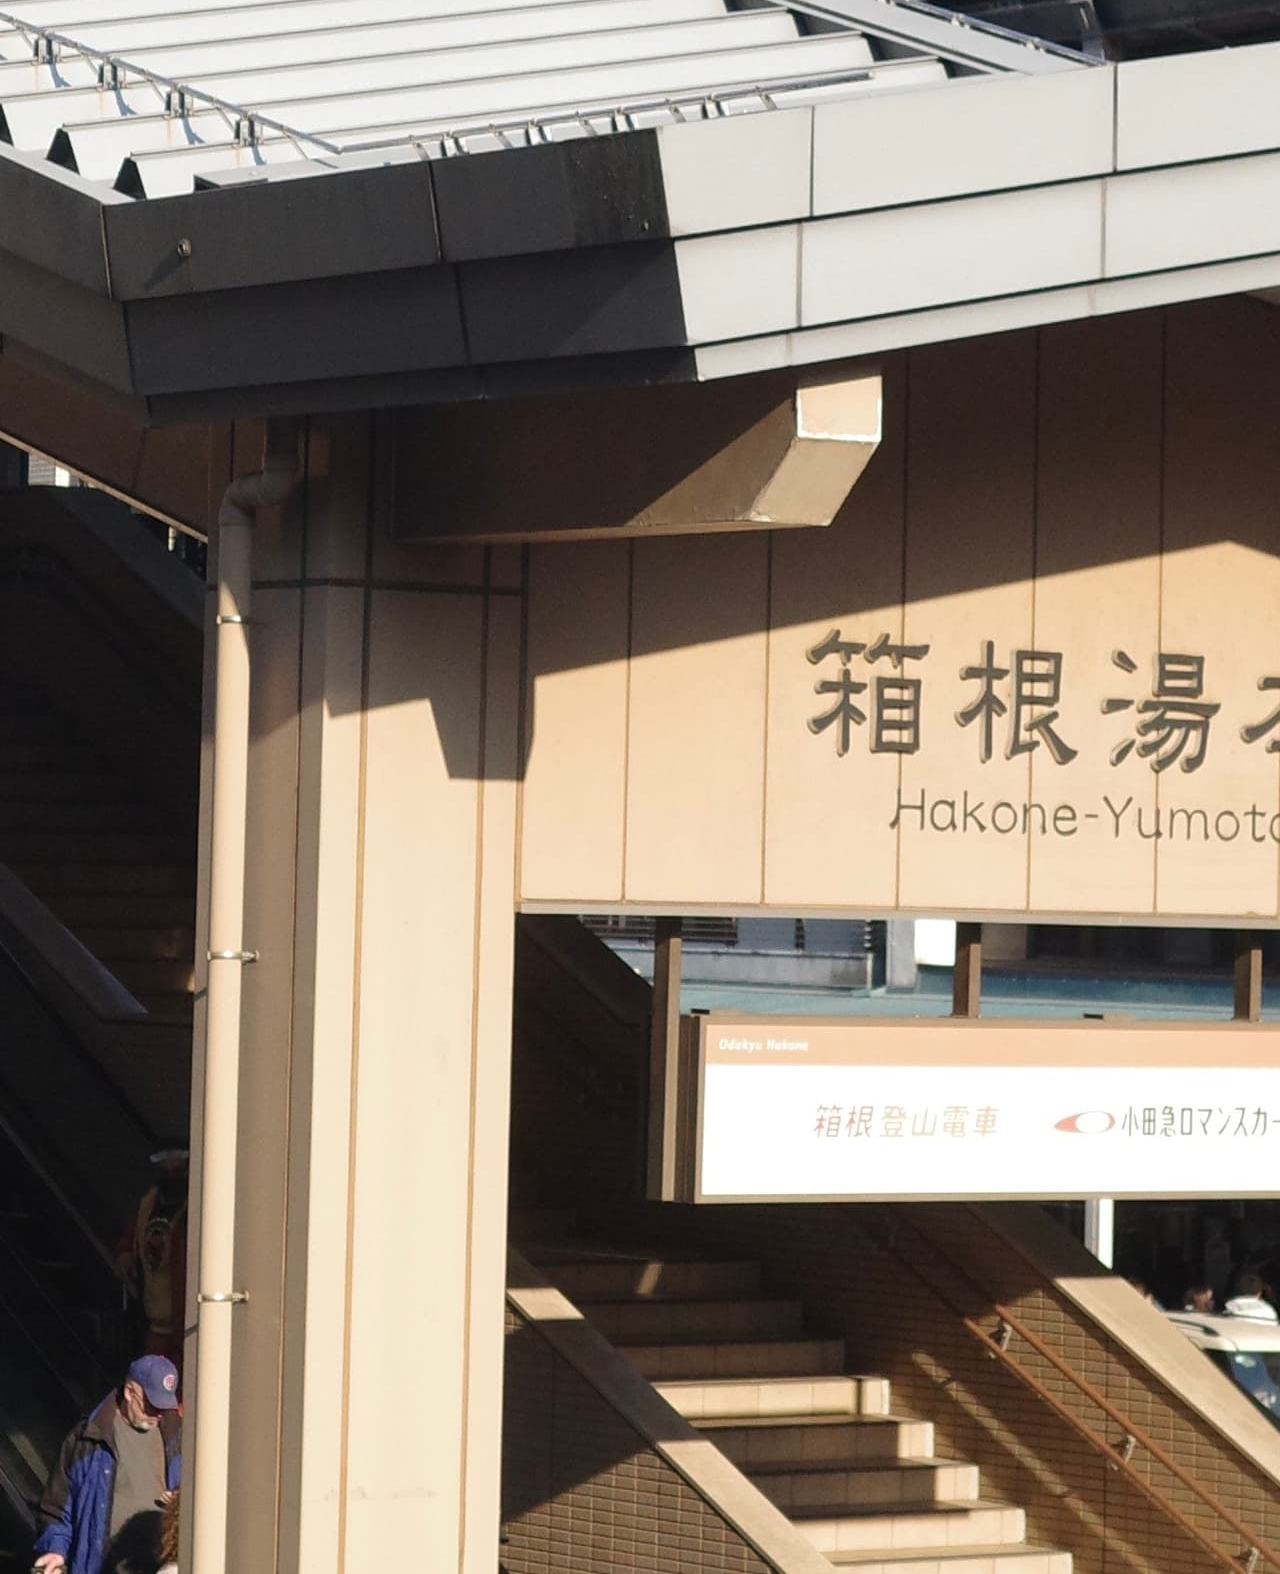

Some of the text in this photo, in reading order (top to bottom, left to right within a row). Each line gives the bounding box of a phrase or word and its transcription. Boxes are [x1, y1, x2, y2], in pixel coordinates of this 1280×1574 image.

[719, 1038, 762, 1053] Odakyu
[813, 1104, 999, 1139] 箱根登山電車
